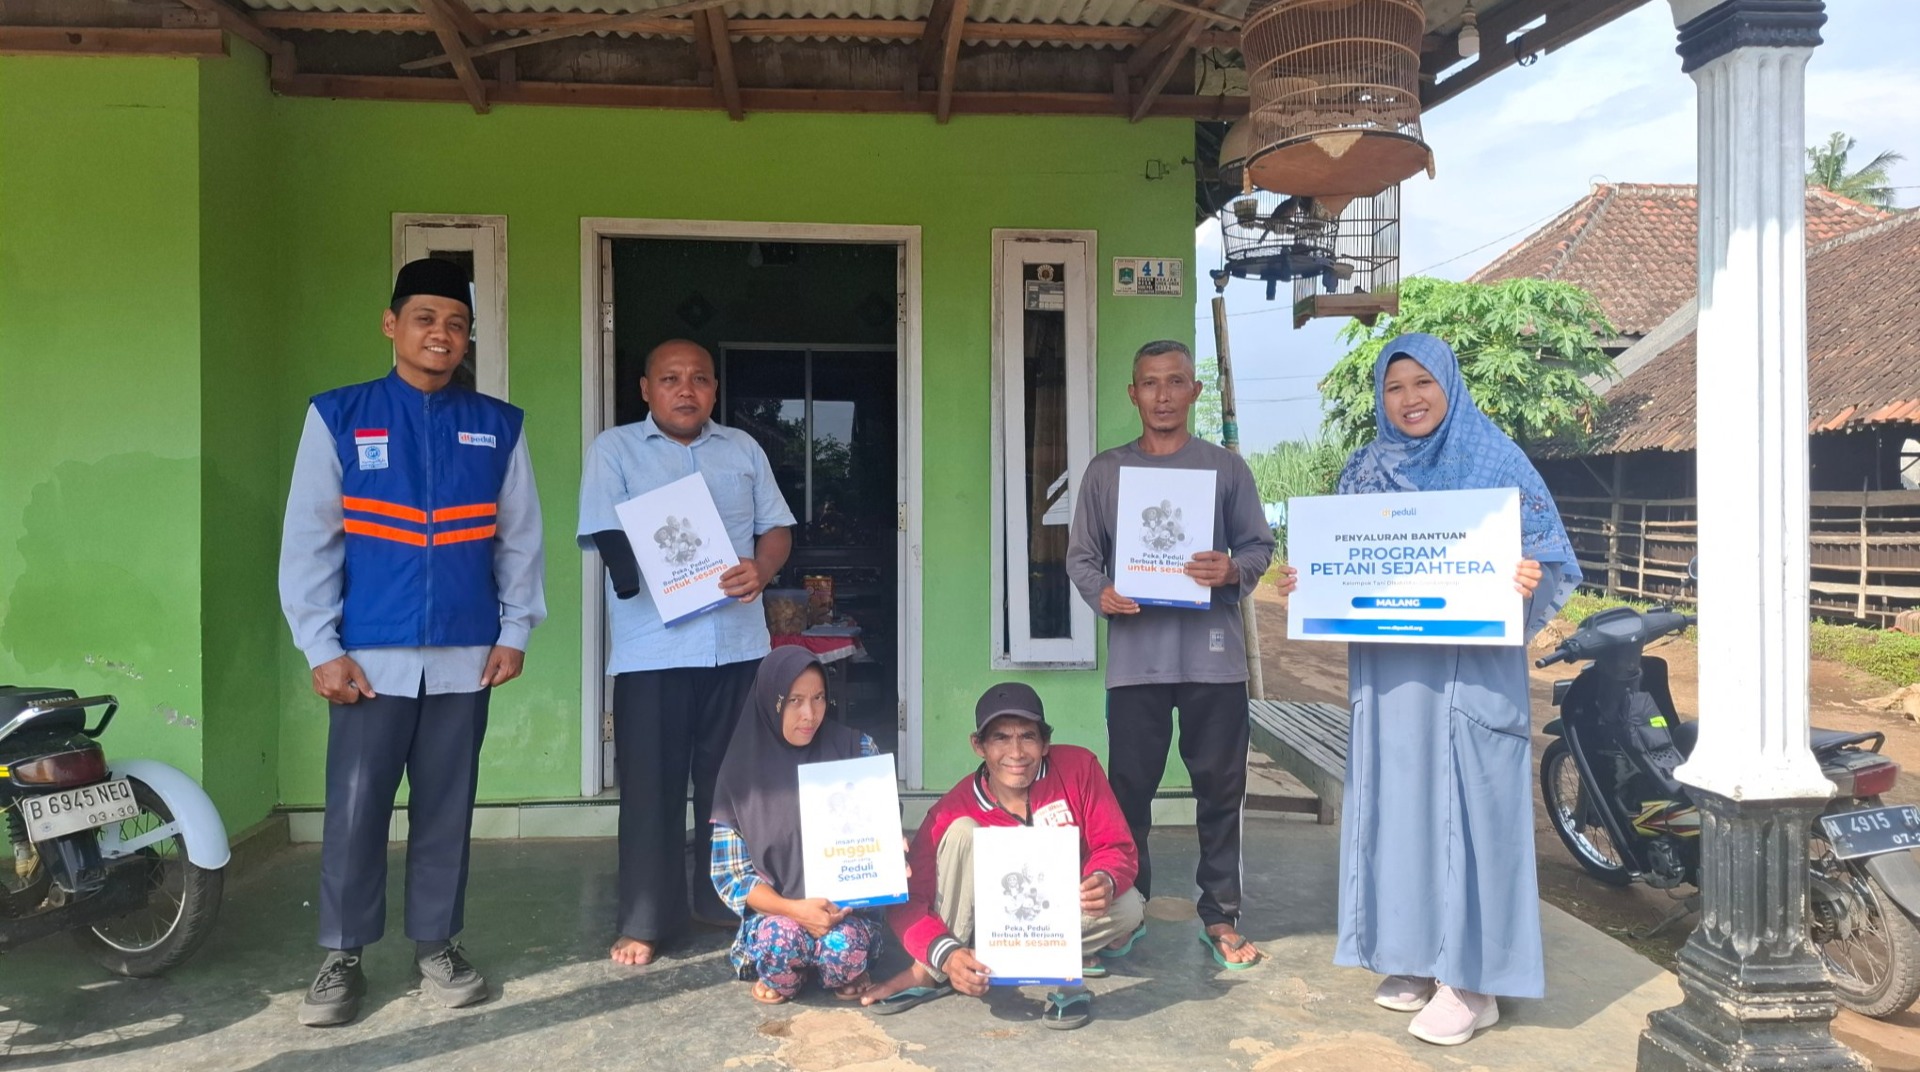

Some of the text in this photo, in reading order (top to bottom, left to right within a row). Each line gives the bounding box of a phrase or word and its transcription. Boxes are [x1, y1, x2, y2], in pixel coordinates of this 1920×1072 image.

[1335, 532, 1466, 542] PENYALURAN BANTUAN
[1349, 546, 1446, 560] PROGRAM
[1128, 564, 1157, 572] untuk
[1311, 561, 1496, 576] PETANI SEJAHTERA
[663, 564, 728, 594] untuk sesama
[1376, 598, 1420, 608] MALANG
[30, 782, 130, 820] B 6945 NEQ
[1827, 820, 1842, 836] N
[1851, 812, 1891, 832] 4915
[824, 840, 881, 858] Unggul
[841, 861, 874, 873] Peduli
[838, 871, 878, 882] Sesama
[989, 939, 1021, 947] untuk
